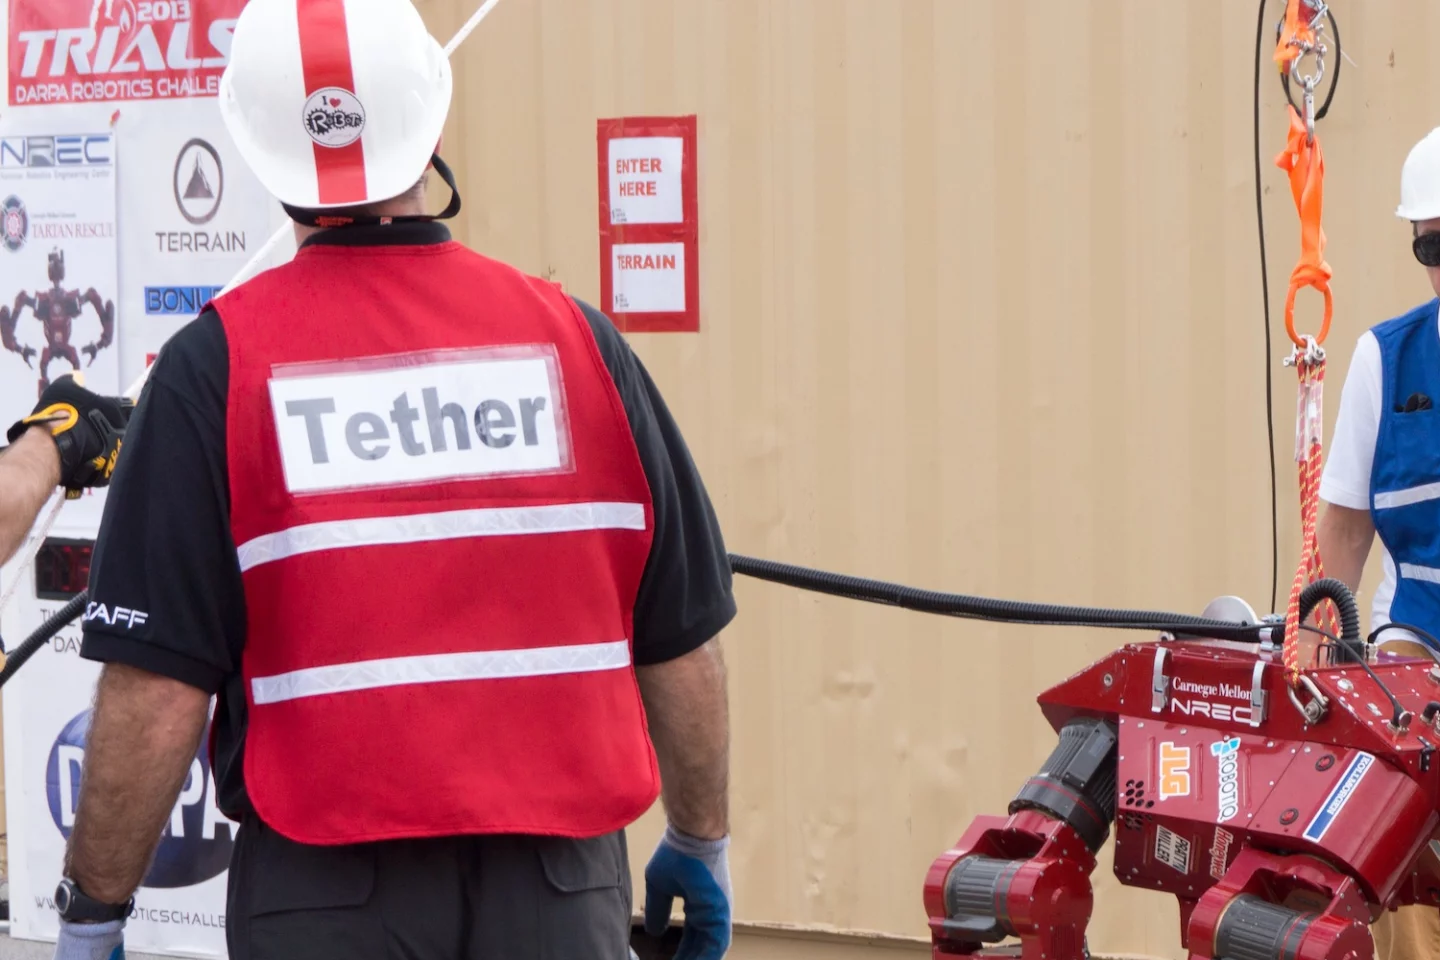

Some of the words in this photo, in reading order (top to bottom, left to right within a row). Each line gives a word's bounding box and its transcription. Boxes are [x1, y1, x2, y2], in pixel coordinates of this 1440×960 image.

[137, 0, 190, 21] 2013
[18, 18, 232, 78] TRIALS
[16, 83, 69, 103] DARPA
[71, 80, 153, 101] ROBOTICS
[157, 77, 220, 97] CHALLE
[1, 136, 110, 166] NREC
[615, 158, 662, 174] ENTER
[619, 181, 657, 197] HERE
[155, 231, 246, 252] TERRAIN
[617, 254, 676, 270] TERRAIN
[285, 386, 547, 465] Tether
[1172, 676, 1217, 698] Carnegie
[1171, 697, 1253, 723] NREC
[1161, 743, 1190, 797] JLG
[1219, 752, 1238, 820] ROBOTIQ
[1156, 826, 1172, 863] MILLER
